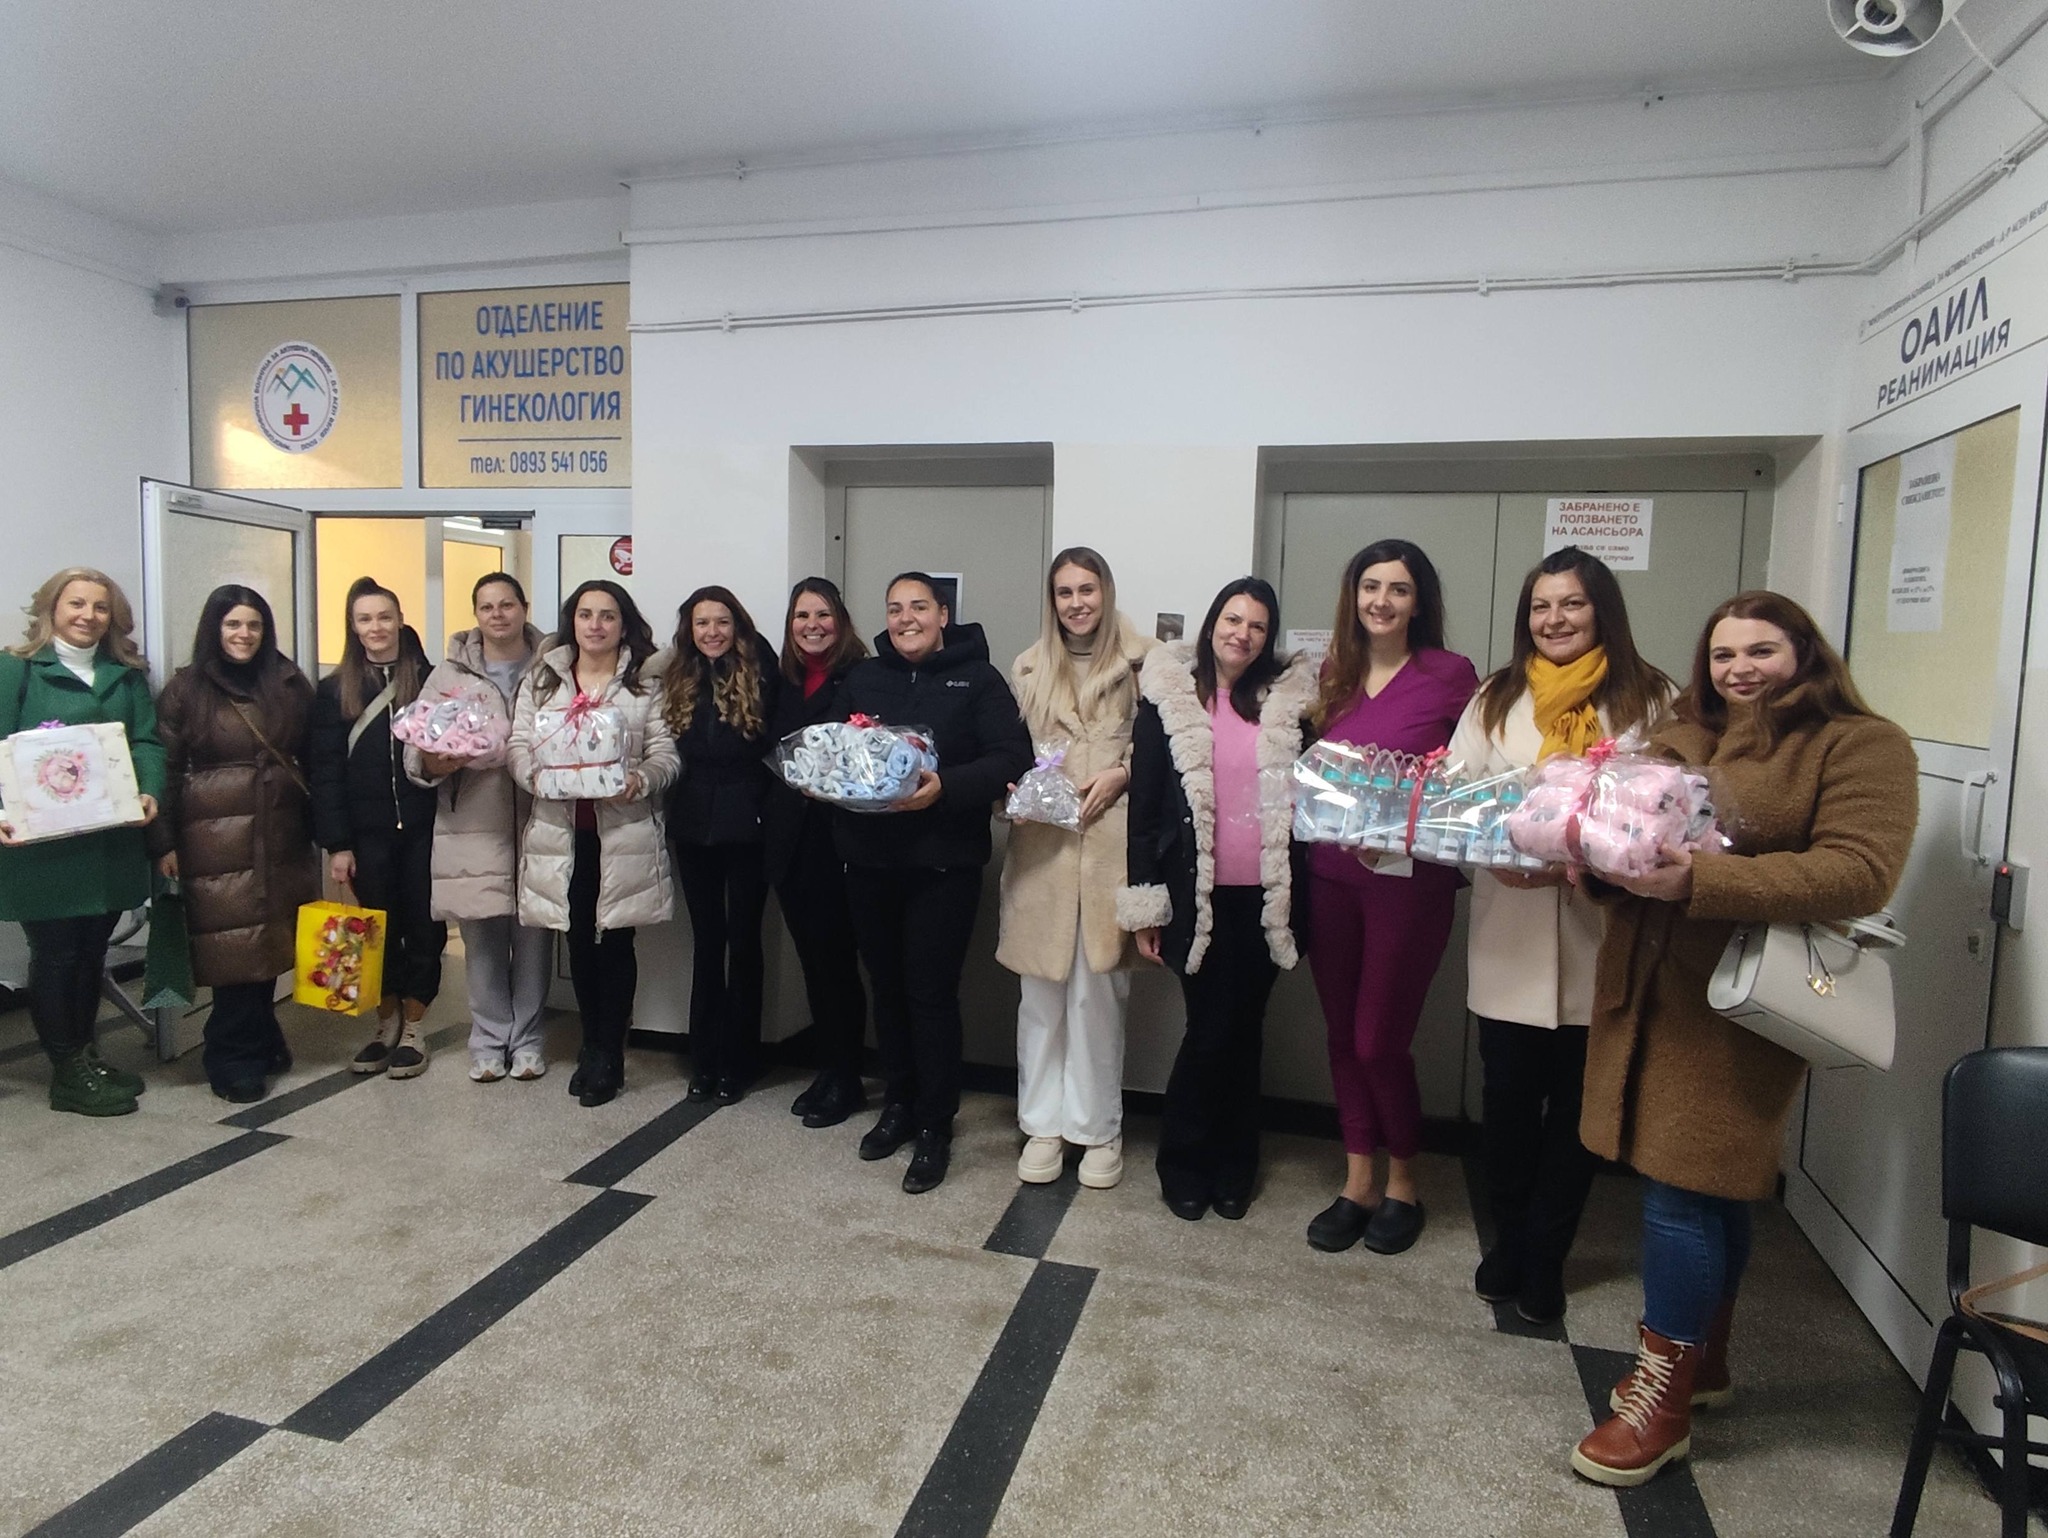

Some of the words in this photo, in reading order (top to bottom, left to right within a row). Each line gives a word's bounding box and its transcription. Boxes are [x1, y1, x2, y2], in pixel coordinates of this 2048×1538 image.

[476, 301, 604, 338] ОТДЕЛЕНИЕ
[1900, 276, 1988, 365] ОАИЛ
[436, 351, 465, 381] ПО
[471, 345, 625, 379] АКУШЕРСТВО
[1877, 318, 2011, 410] РЕАНИМАЦИЯ
[460, 390, 621, 423] ГИНЕКОЛОГИЯ
[470, 456, 506, 473] тел:
[510, 451, 546, 473] 0893
[551, 451, 574, 473] 541
[579, 450, 608, 473] 056
[1559, 502, 1630, 512] ЗАБРАНЕНО
[1633, 503, 1640, 512] Е
[1560, 514, 1639, 525] ПОЛЗВАНЕТО
[1552, 526, 1568, 536] НА
[1570, 526, 1644, 537] АСАНСЬОРА
